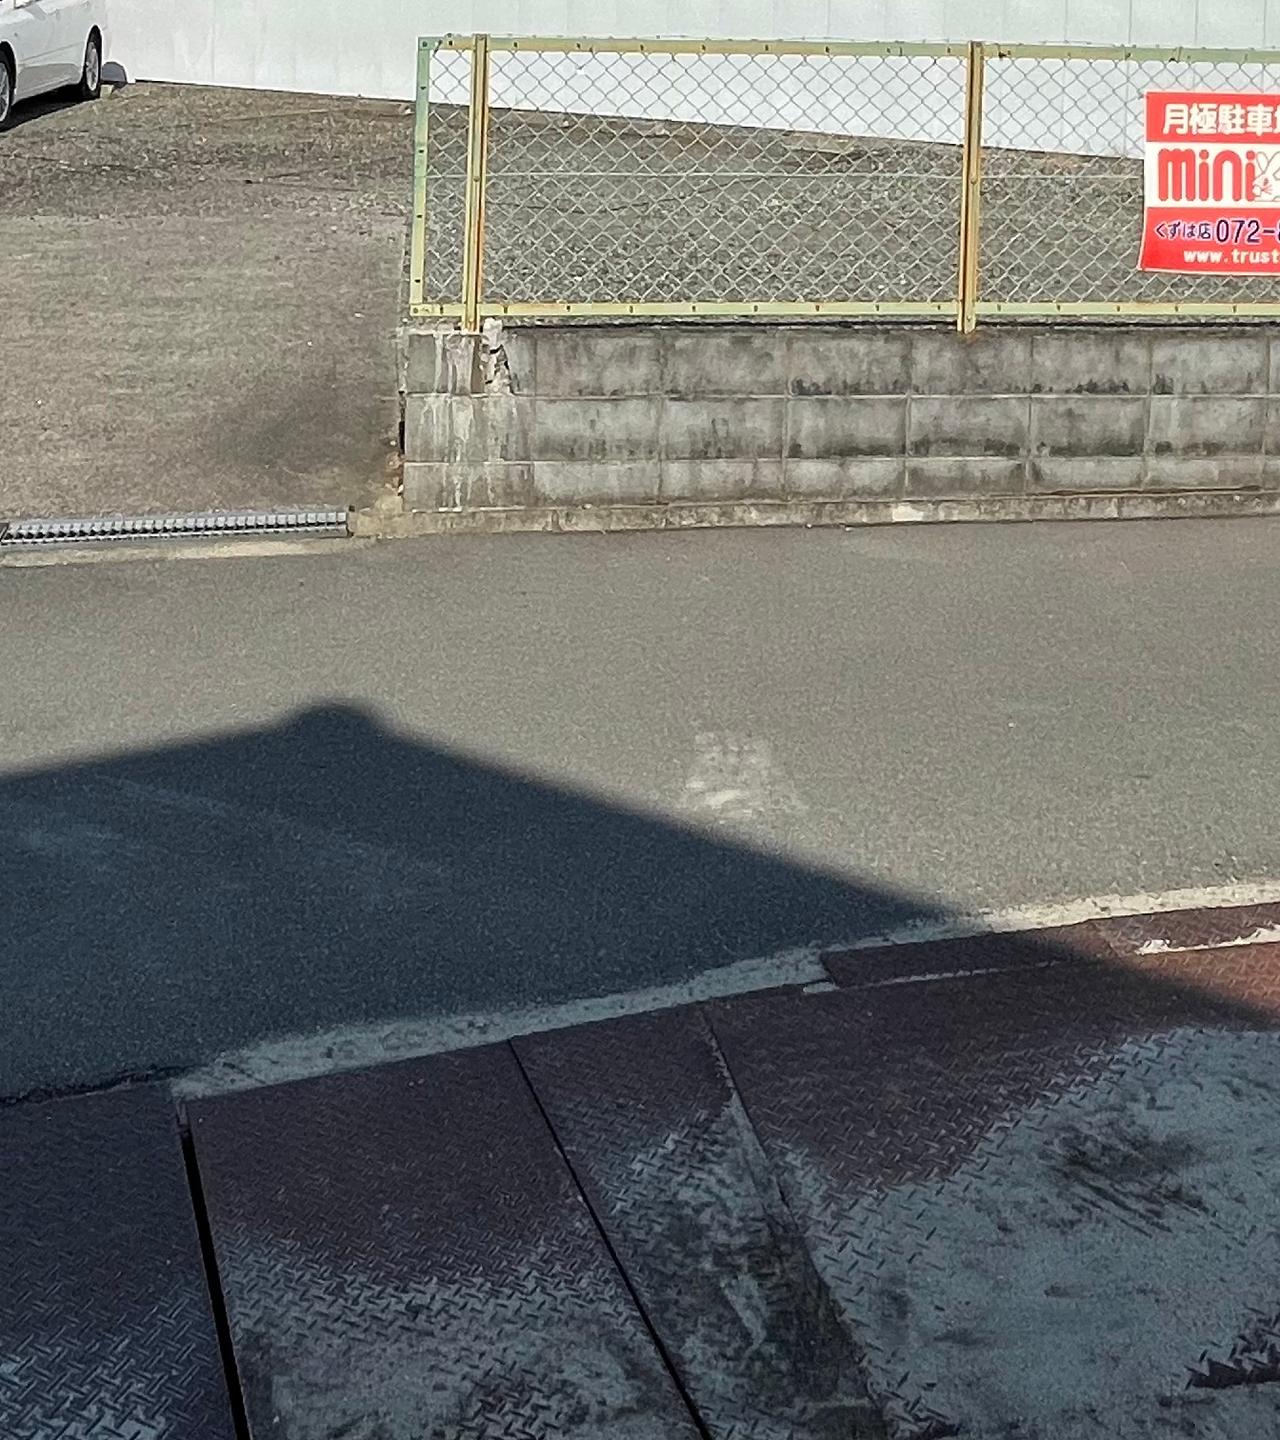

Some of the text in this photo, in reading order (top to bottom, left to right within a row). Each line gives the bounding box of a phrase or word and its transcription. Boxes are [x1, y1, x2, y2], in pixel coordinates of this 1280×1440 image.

[1158, 148, 1255, 202] mini
[1155, 221, 1212, 240] くずは店
